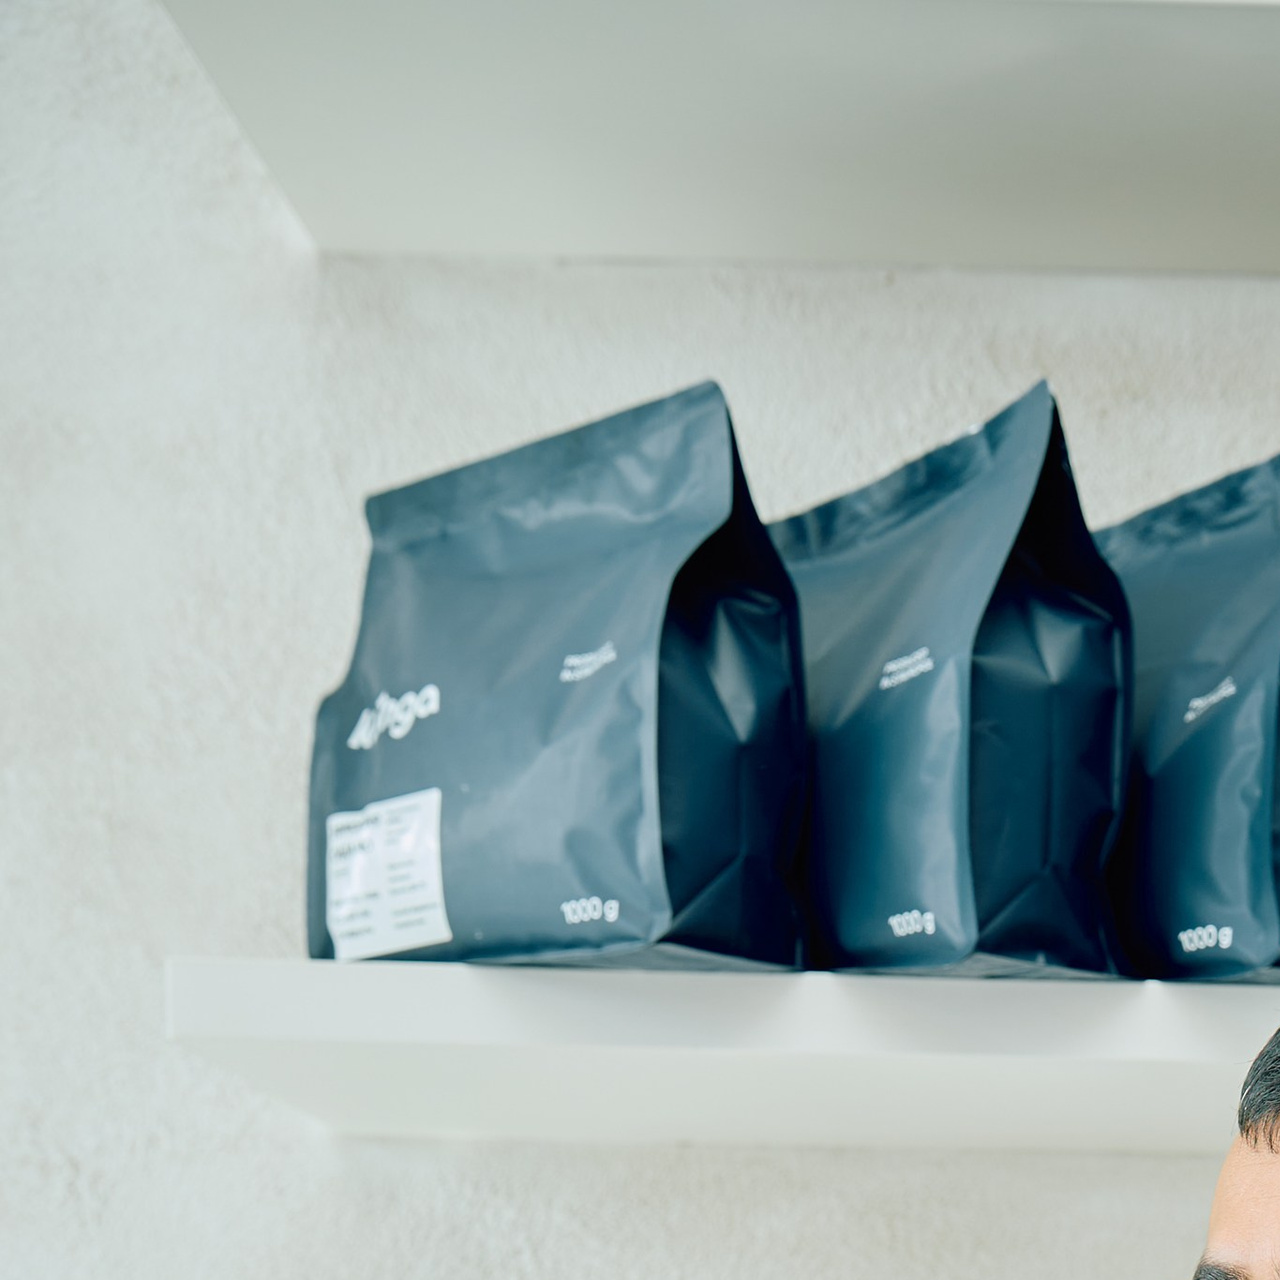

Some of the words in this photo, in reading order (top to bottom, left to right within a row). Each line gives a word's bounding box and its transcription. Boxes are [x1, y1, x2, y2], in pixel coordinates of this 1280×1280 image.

[560, 896, 602, 924] 1000
[603, 899, 619, 922] g
[1178, 924, 1217, 952] 1000
